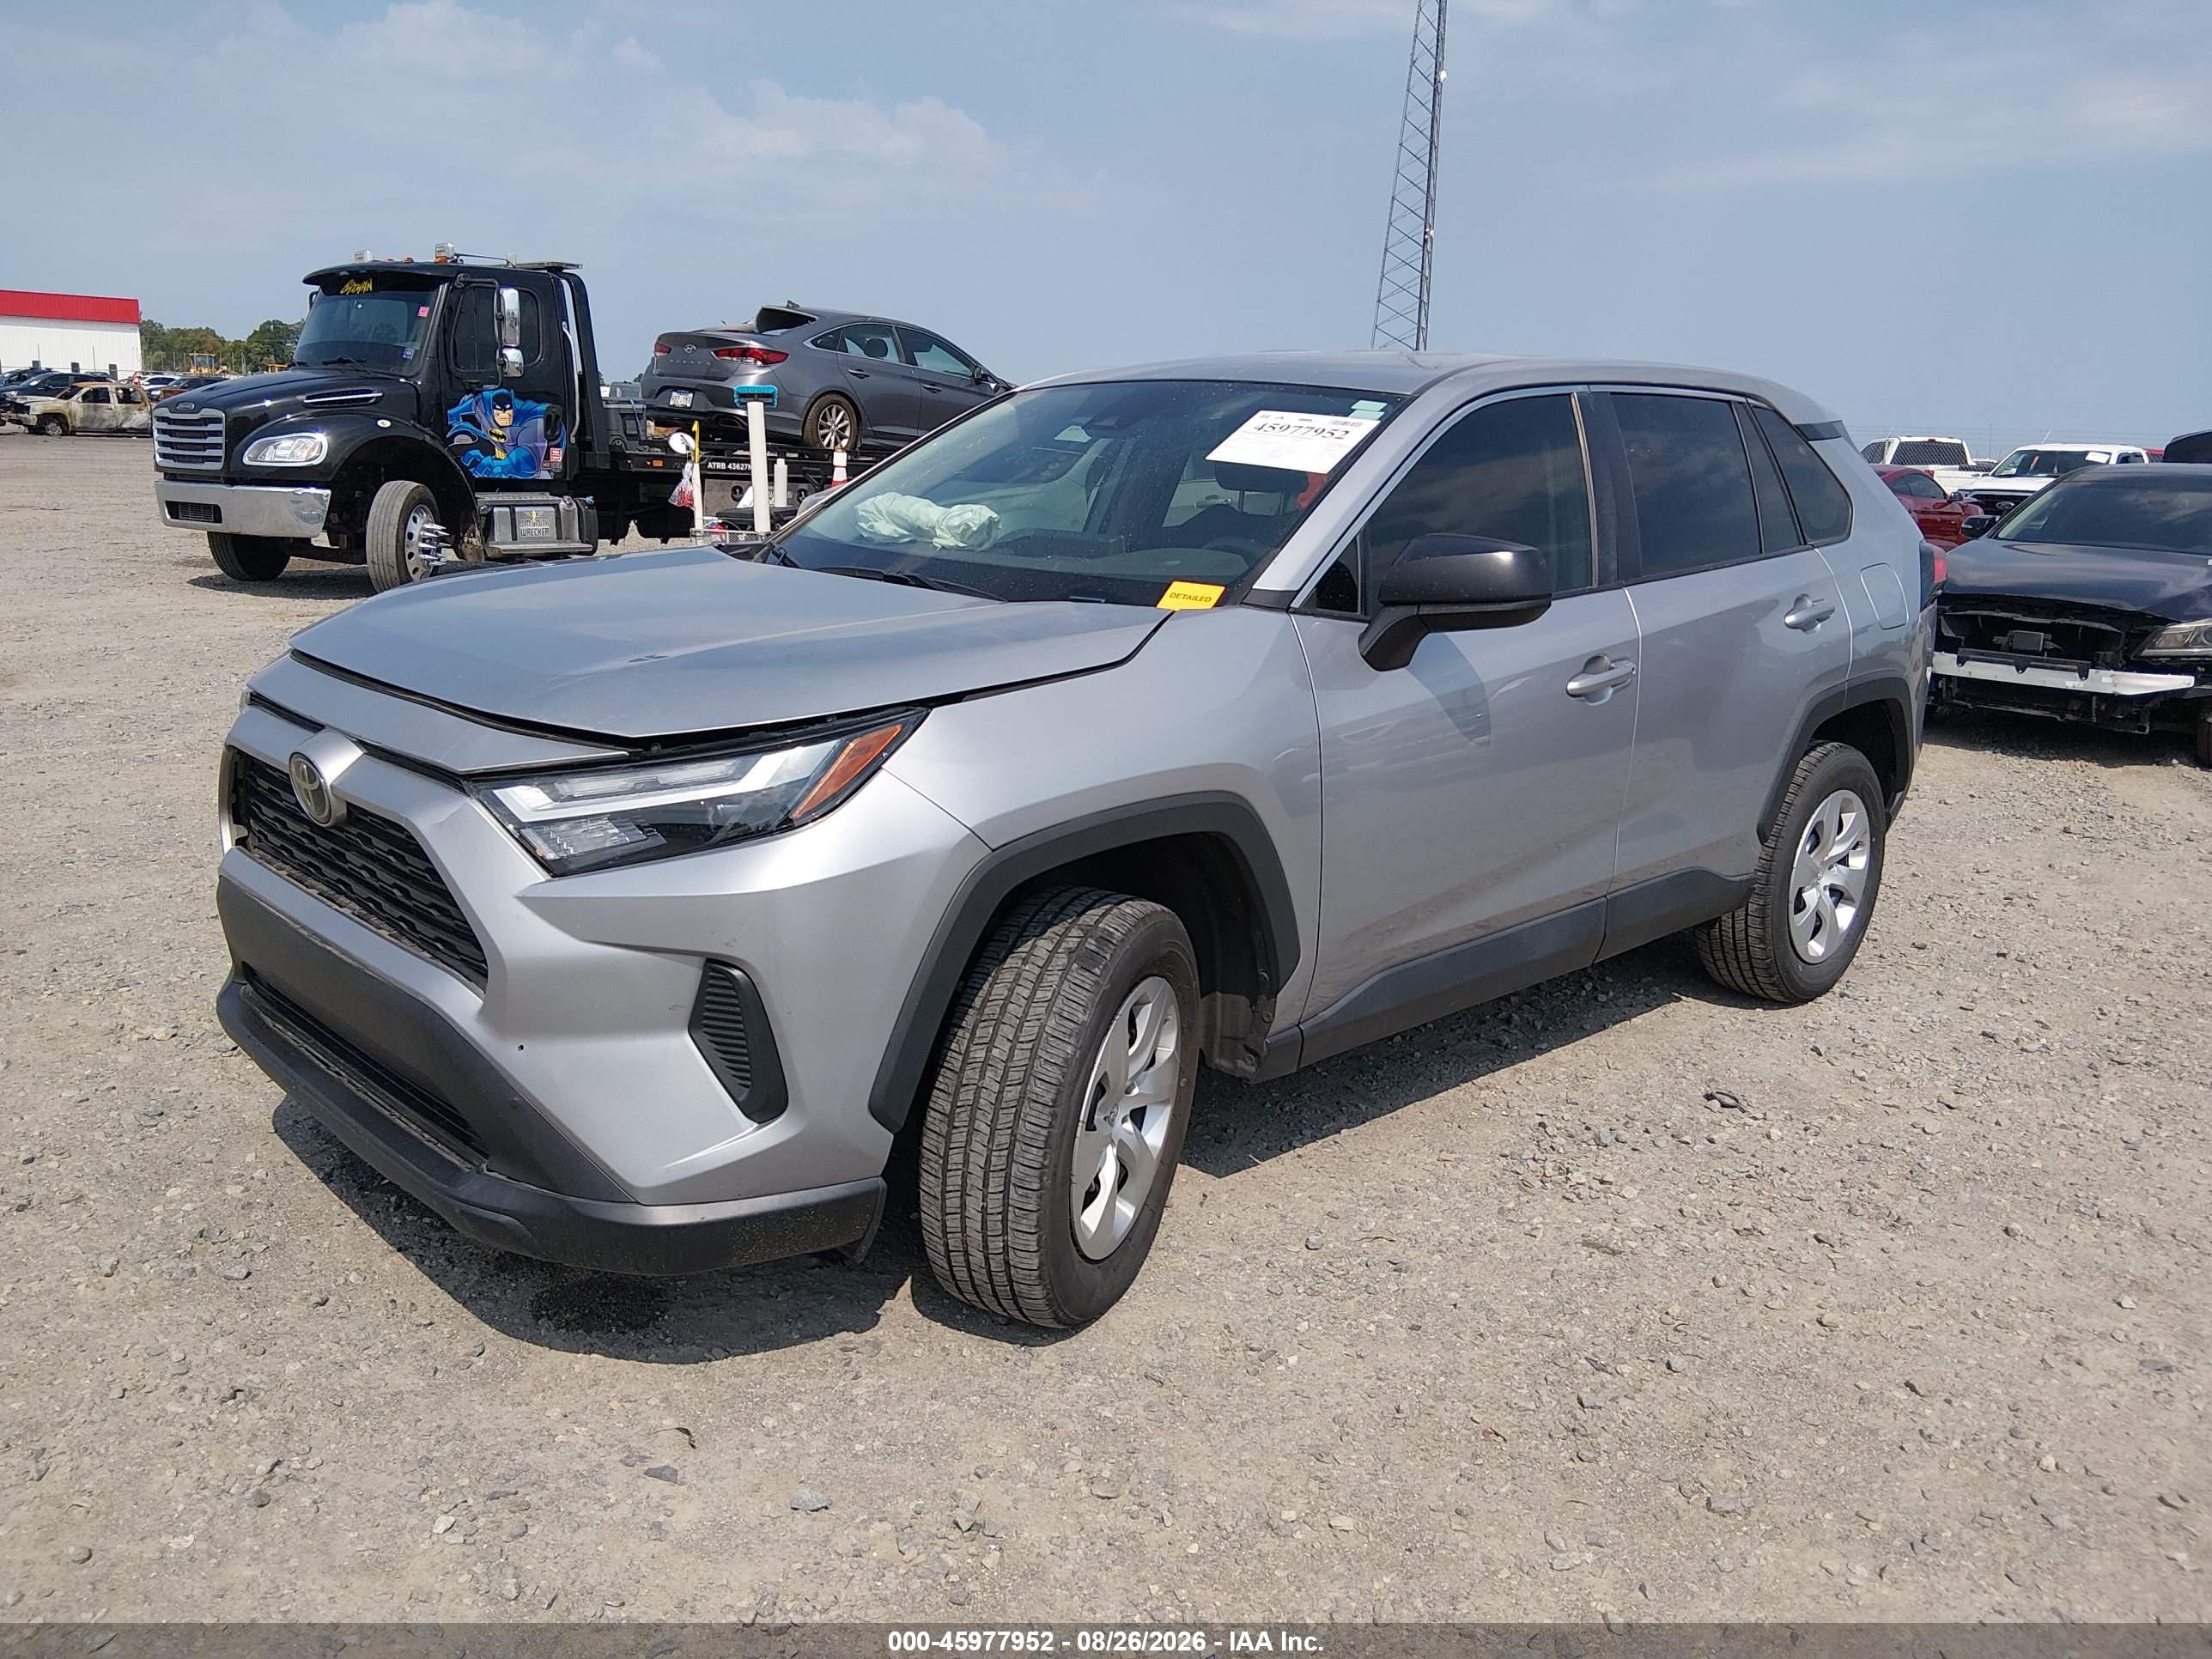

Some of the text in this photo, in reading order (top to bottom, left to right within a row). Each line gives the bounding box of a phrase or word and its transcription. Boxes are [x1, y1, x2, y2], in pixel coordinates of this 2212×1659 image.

[1254, 422, 1351, 440] 45977952
[707, 461, 726, 470] ATRB
[521, 528, 550, 537] WRECKER
[1169, 592, 1212, 603] DETAILED
